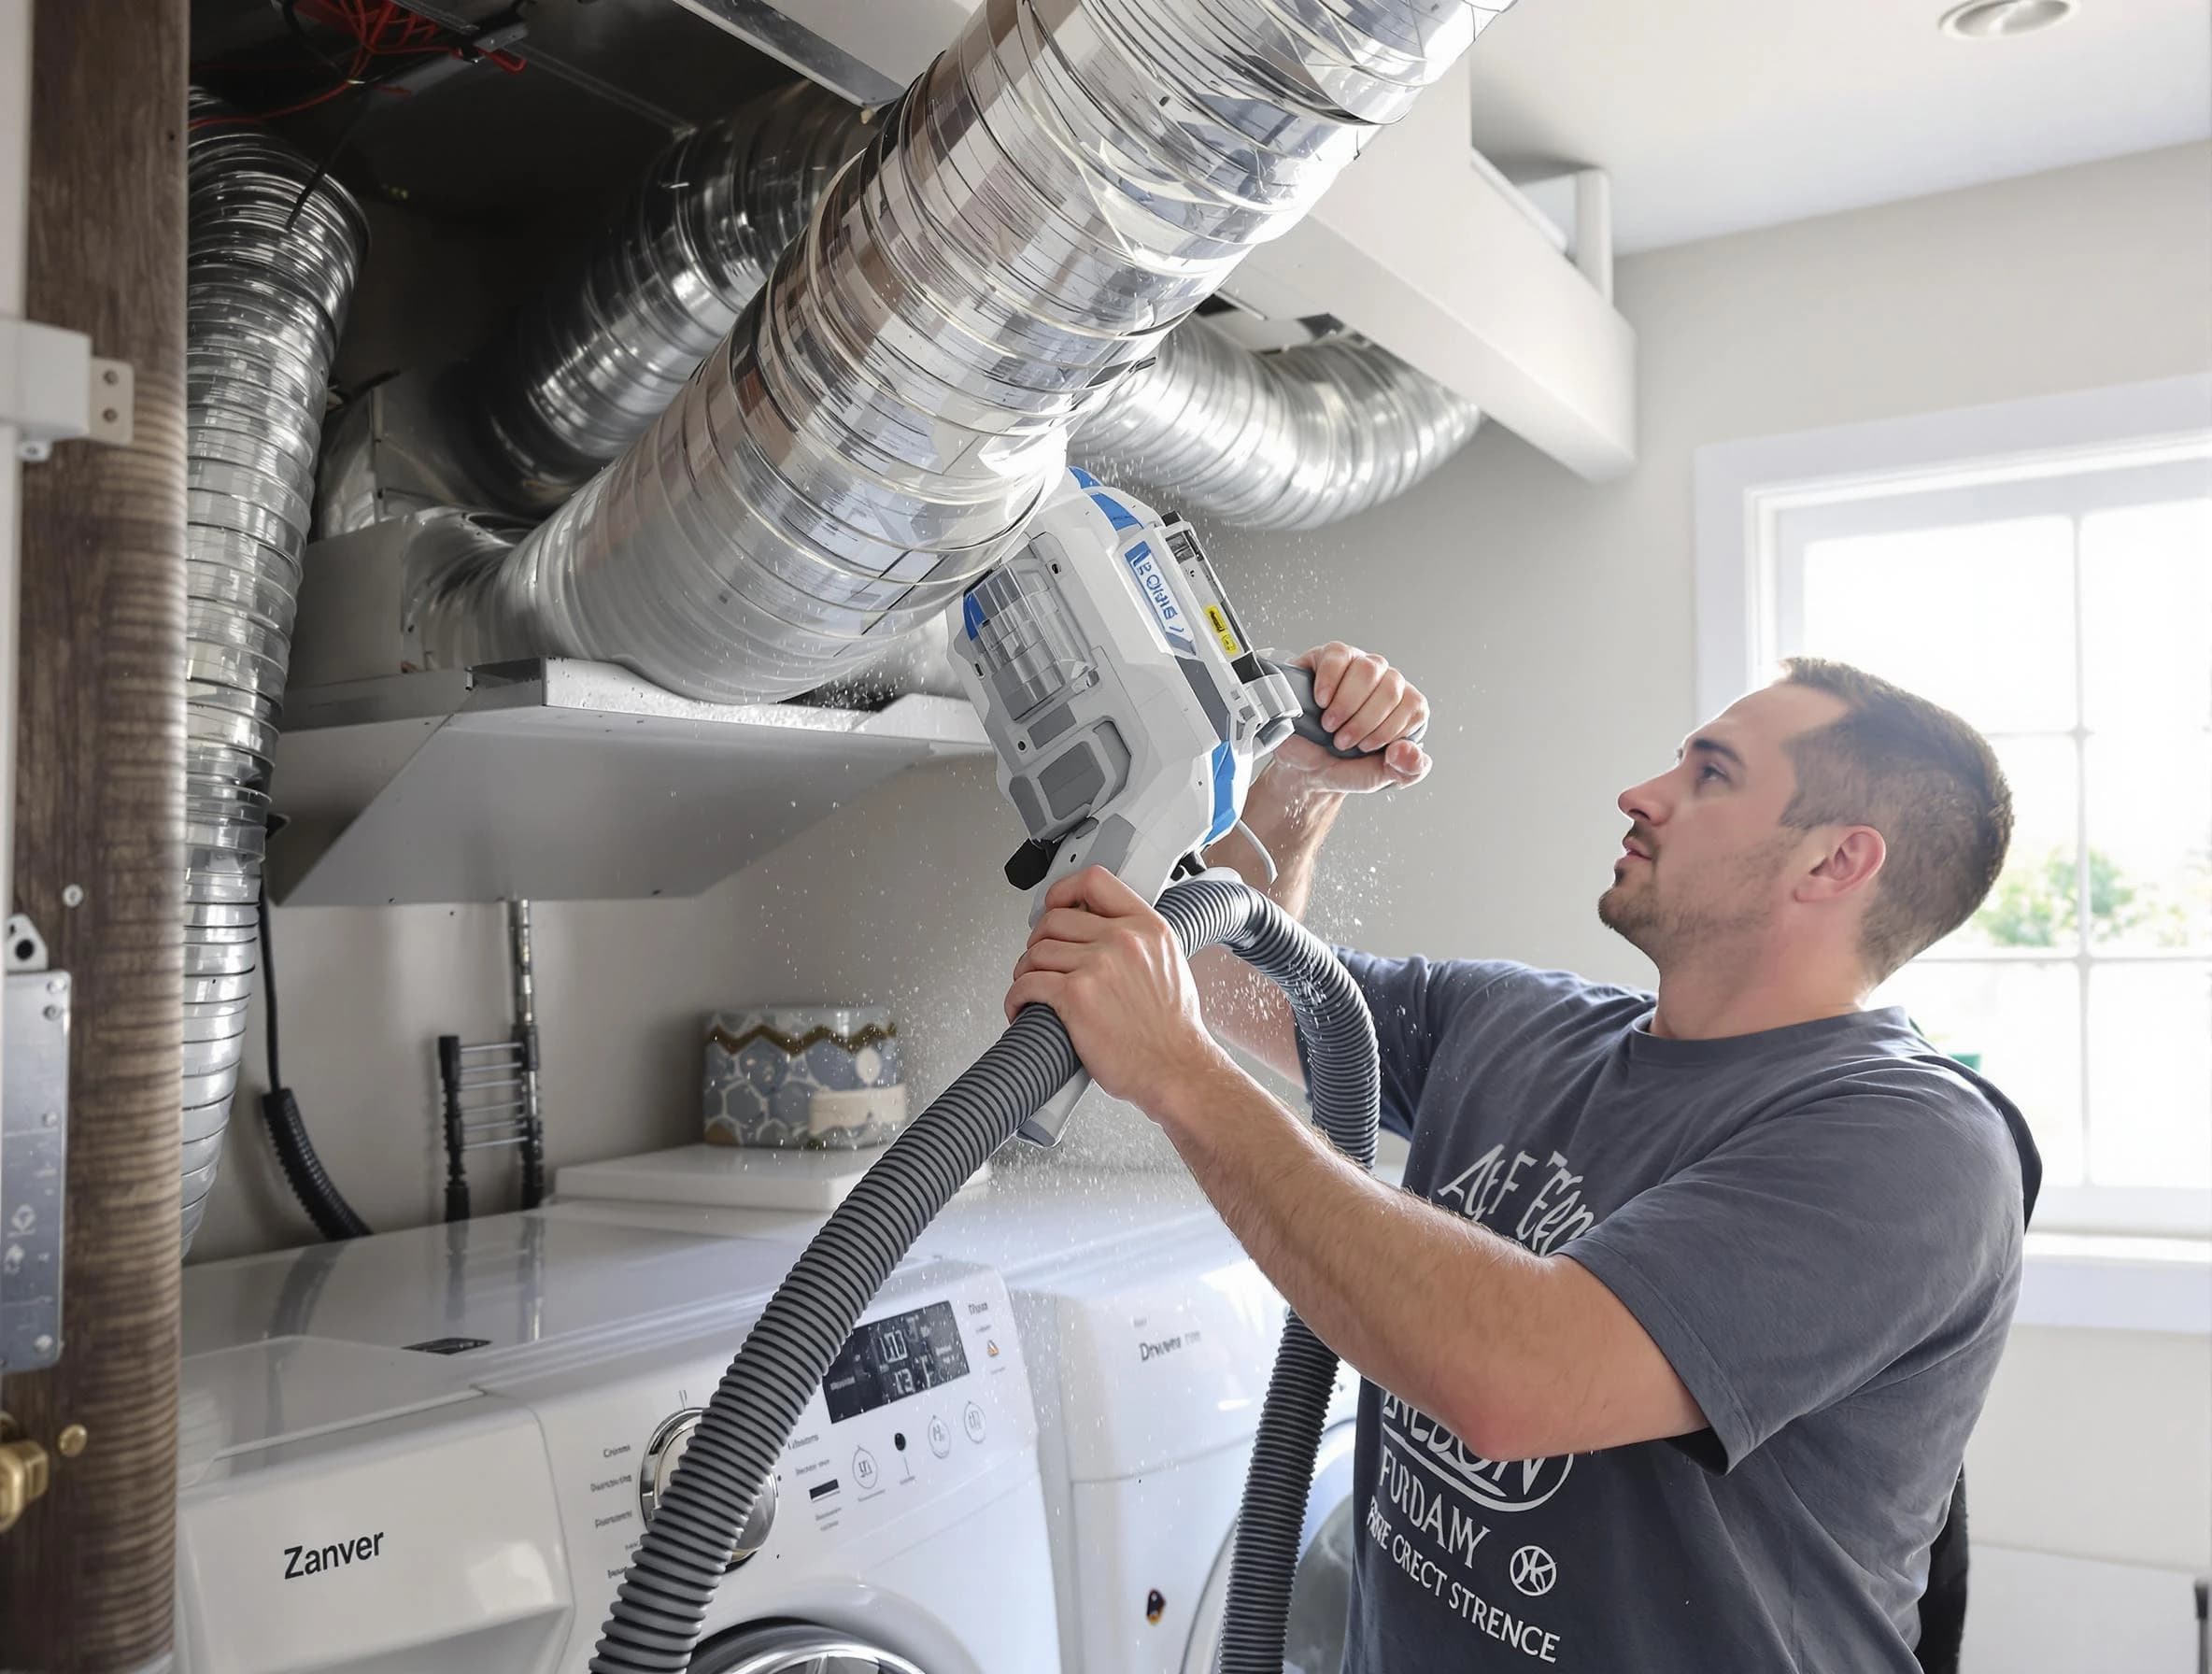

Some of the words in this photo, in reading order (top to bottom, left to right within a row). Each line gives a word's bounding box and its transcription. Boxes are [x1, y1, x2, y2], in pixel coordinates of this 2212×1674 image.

[284, 1531, 384, 1580] Zanver
[1392, 1534, 1448, 1597] CRECT
[1448, 1582, 1561, 1664] STRENCE
